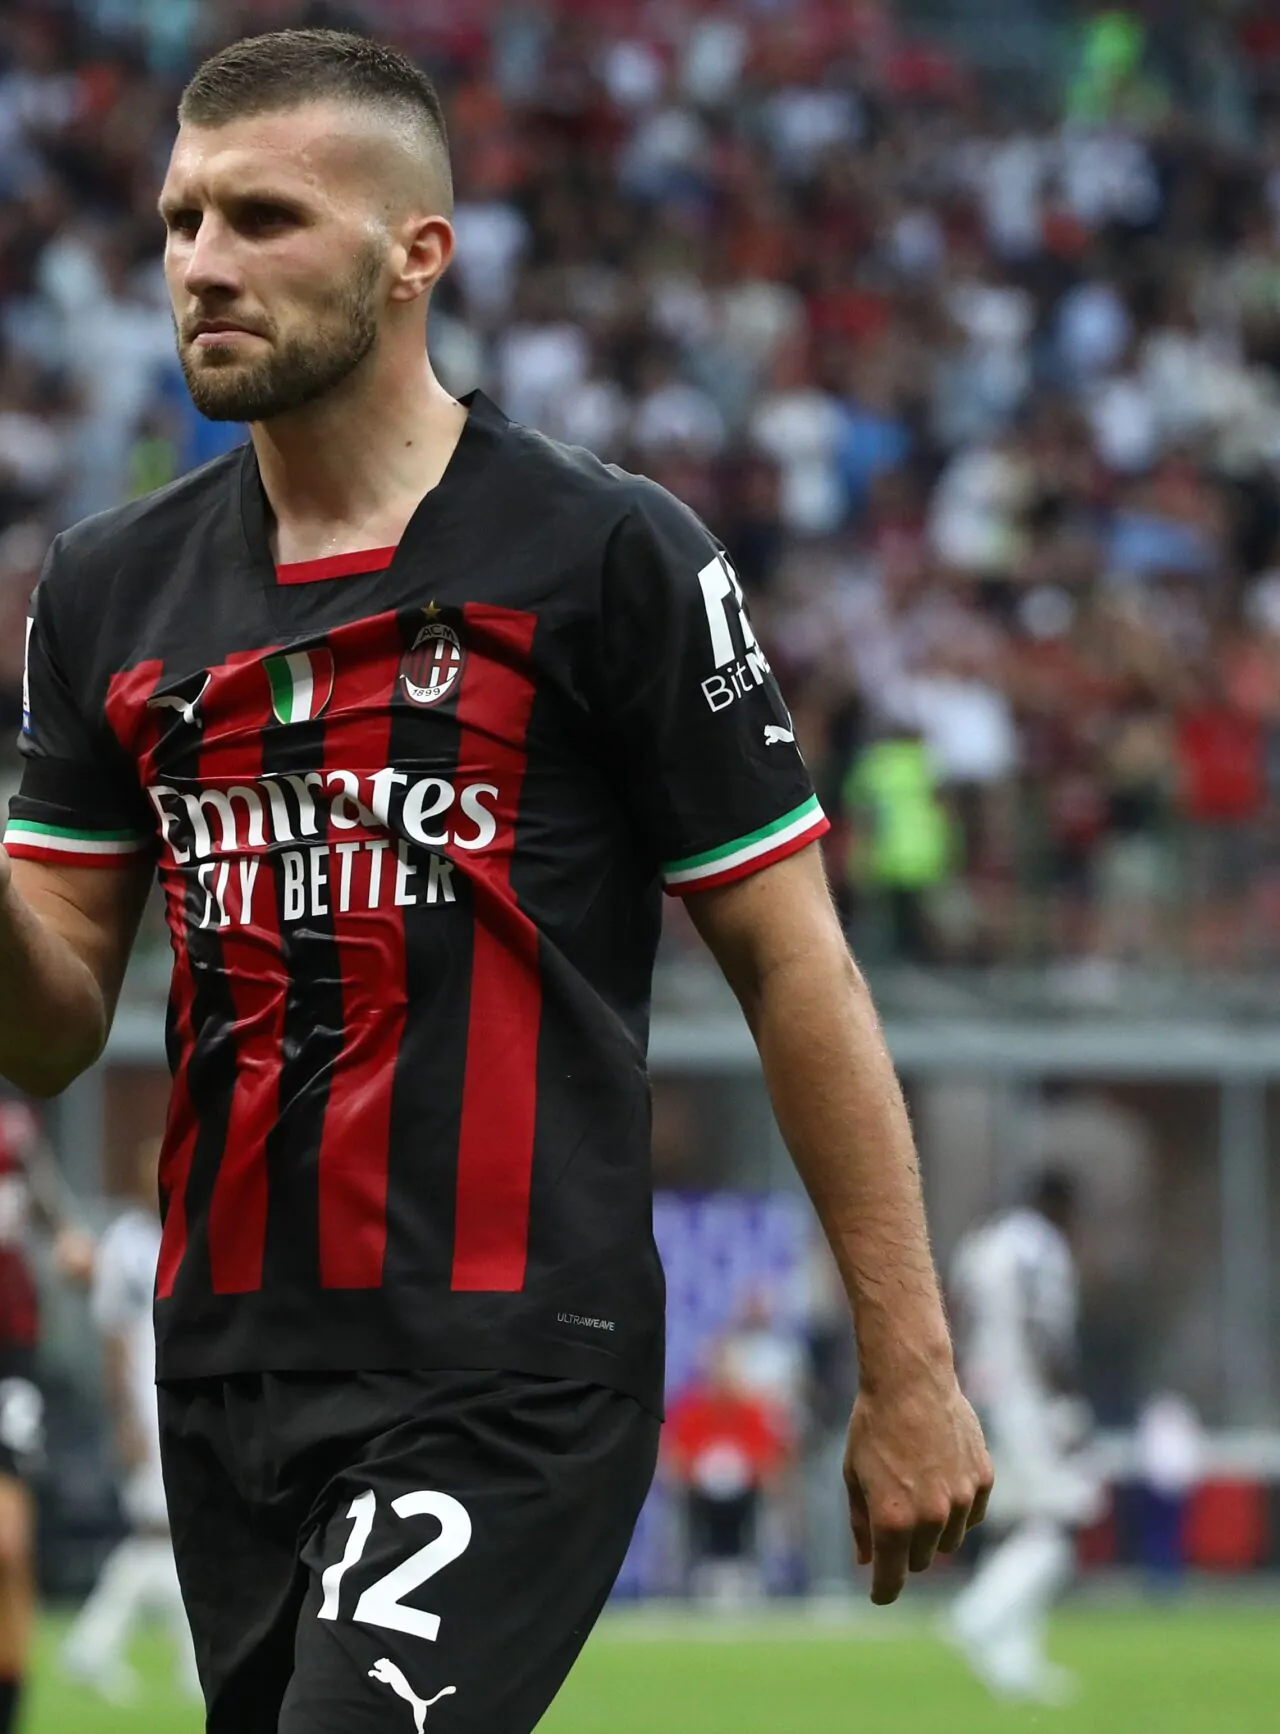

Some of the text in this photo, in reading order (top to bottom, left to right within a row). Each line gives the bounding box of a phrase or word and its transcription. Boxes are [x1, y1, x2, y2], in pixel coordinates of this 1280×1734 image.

[423, 626, 454, 640] ACM
[412, 687, 441, 697] 1899
[146, 767, 499, 864] Emirates
[199, 840, 457, 929] FLY BETTER
[557, 1312, 615, 1331] ULTRAWEAVE
[317, 1488, 472, 1641] 12
